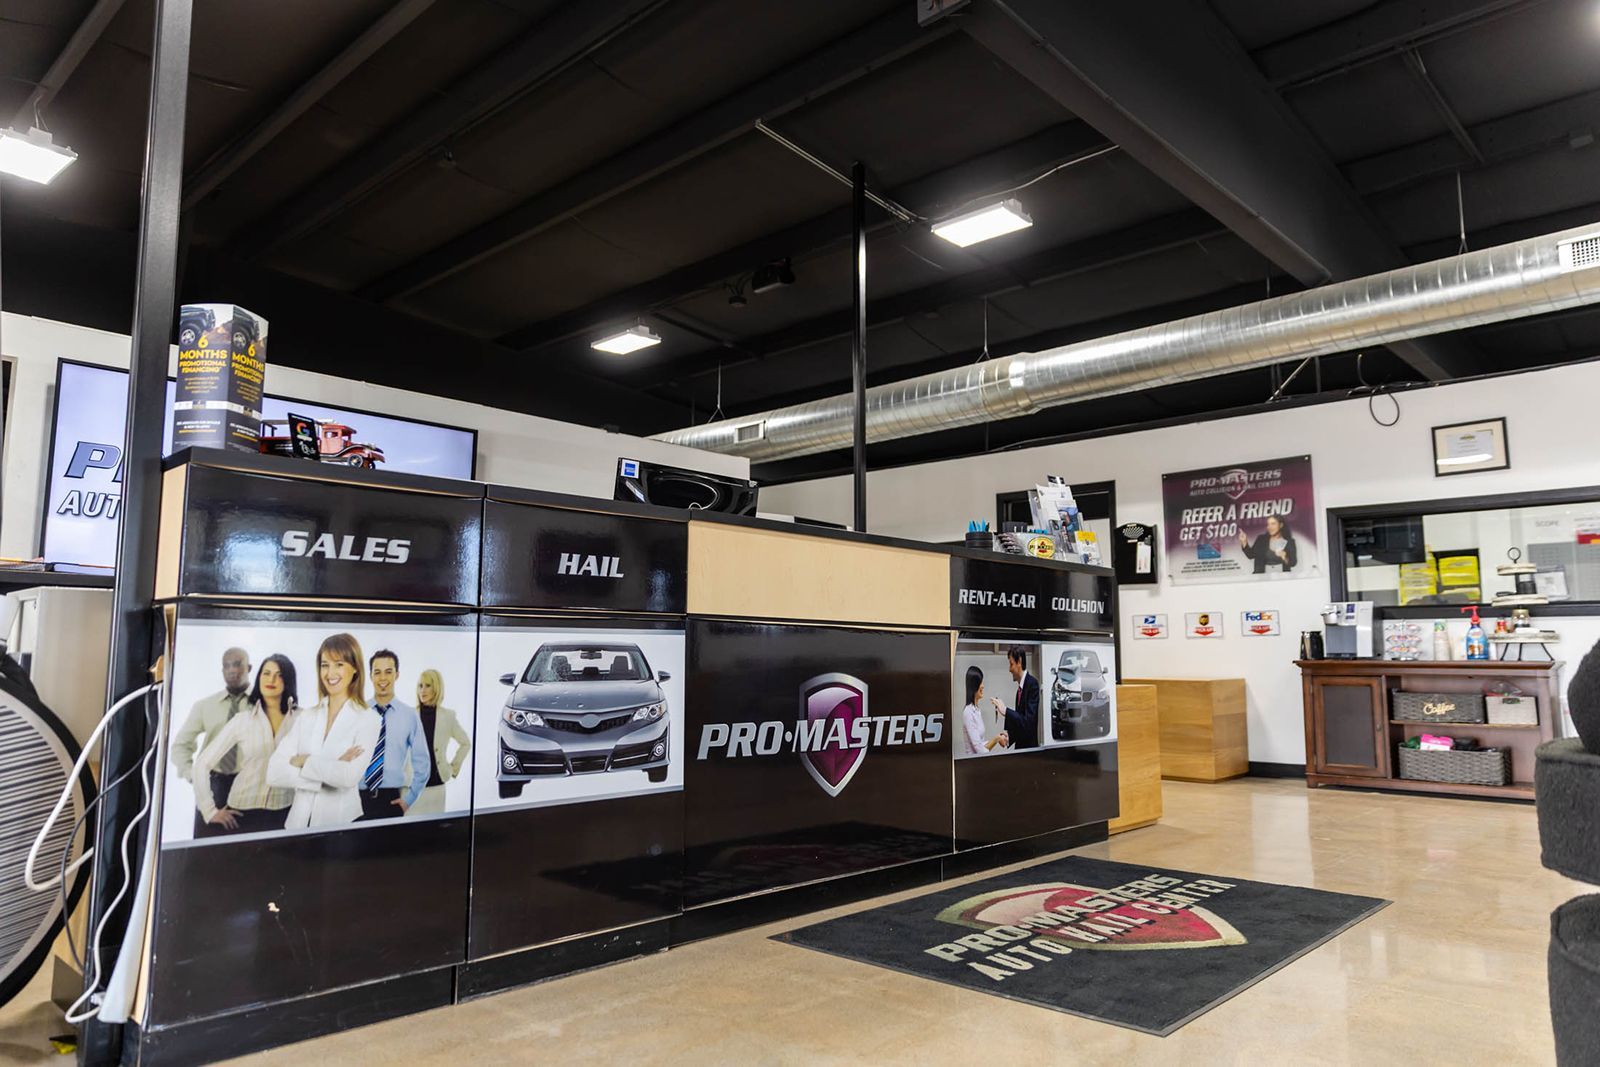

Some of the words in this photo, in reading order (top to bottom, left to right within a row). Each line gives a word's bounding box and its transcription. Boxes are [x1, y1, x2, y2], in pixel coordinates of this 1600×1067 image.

[198, 335, 209, 349] 6
[247, 343, 256, 357] 6
[180, 349, 228, 360] MONTHS
[1189, 488, 1205, 496] AUTO
[1258, 479, 1282, 489] CENTER
[1181, 505, 1225, 526] REFER
[1226, 503, 1237, 521] A
[1240, 498, 1293, 520] FRIEND
[1179, 526, 1203, 541] GET
[1205, 522, 1237, 541] $100
[280, 529, 412, 565] SALES
[557, 552, 625, 579] HAIL
[958, 588, 1036, 609] RENT-A-CAR
[1051, 596, 1105, 614] COLLISION
[1245, 612, 1273, 622] FedEx
[1423, 702, 1456, 715] Coffee
[966, 939, 1073, 981] AUTO
[1057, 913, 1150, 943] HAIL
[1131, 879, 1237, 915] CENTER
